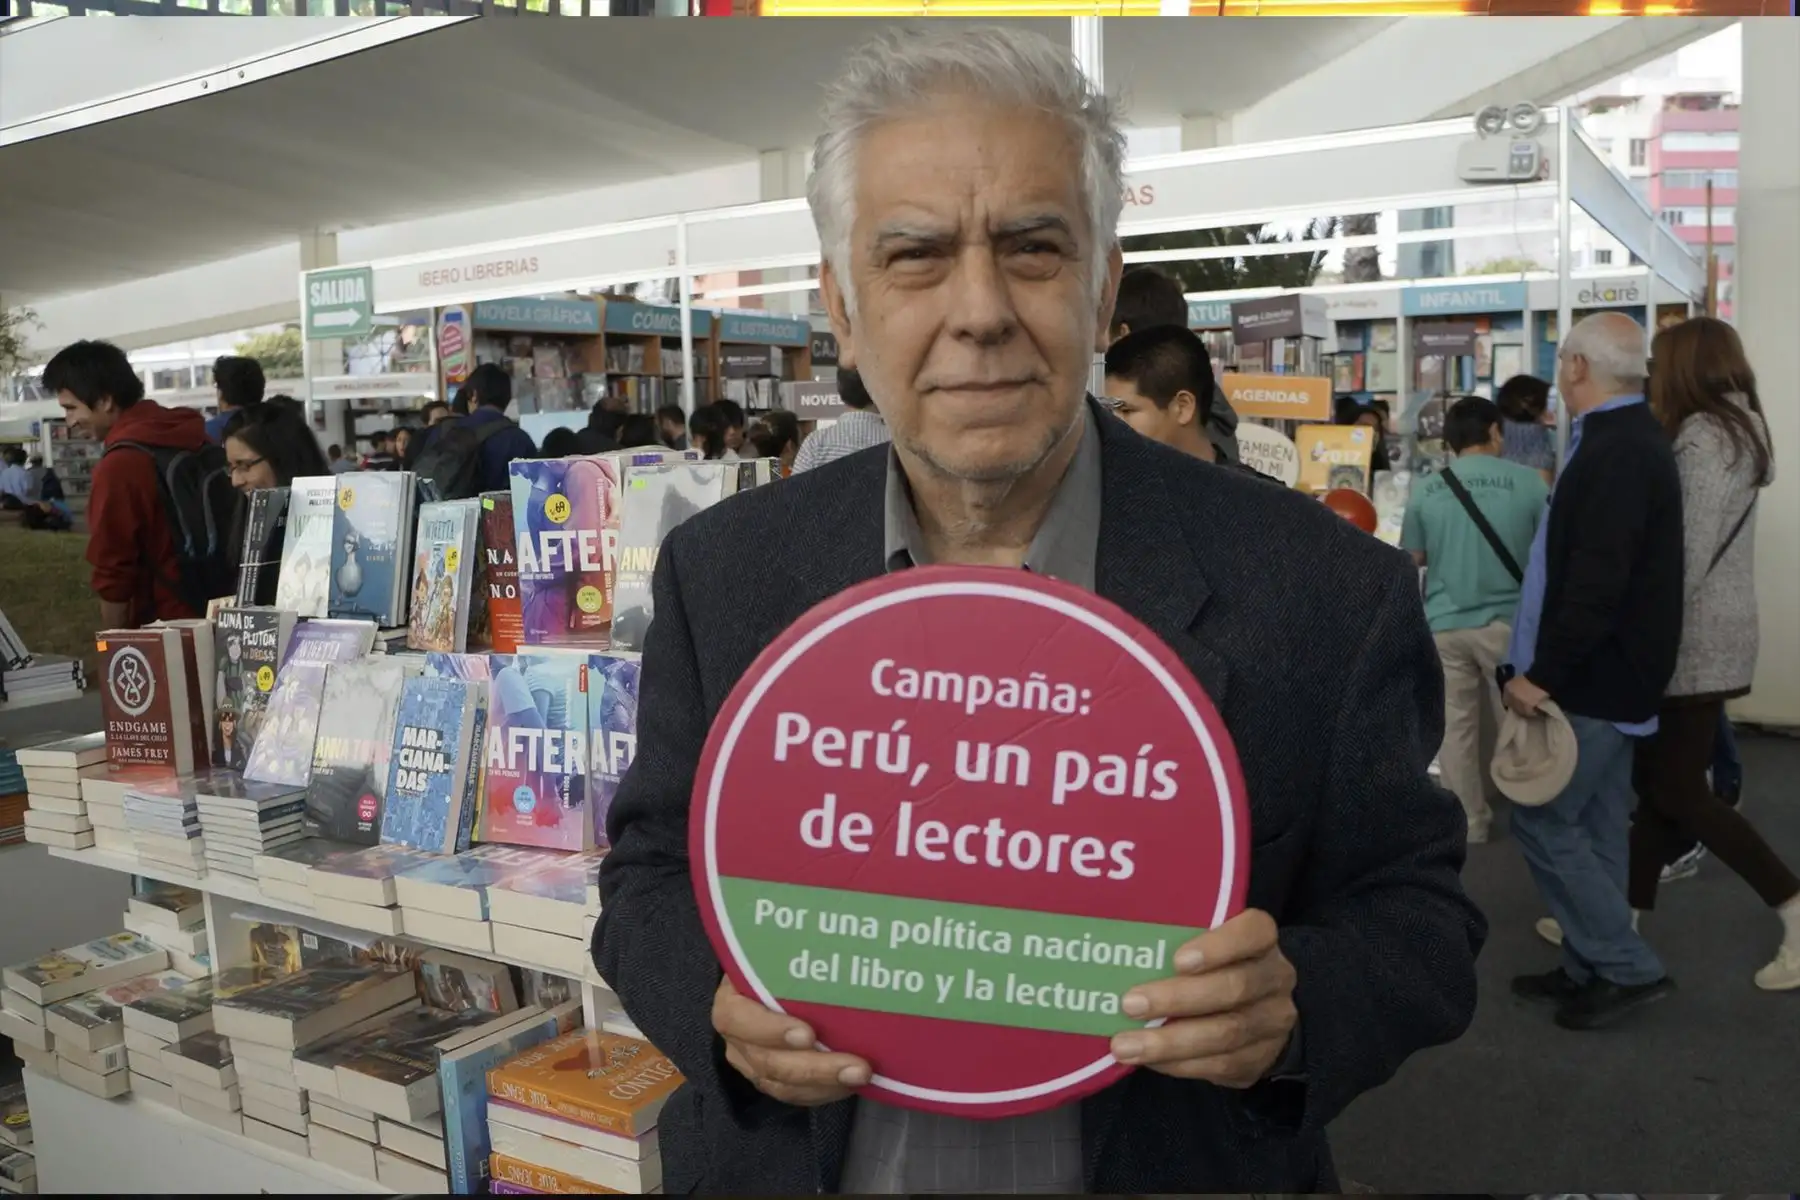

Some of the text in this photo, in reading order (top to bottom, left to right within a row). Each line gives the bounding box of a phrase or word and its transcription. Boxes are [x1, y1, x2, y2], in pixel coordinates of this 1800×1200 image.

[419, 257, 539, 286] IBERO LIBRERIAS
[310, 277, 366, 307] SALIDA
[1419, 290, 1506, 308] INFANTIL
[1577, 281, 1639, 304] ekaré
[476, 305, 531, 322] NOVELA
[632, 308, 682, 331] CÓMIC
[812, 339, 838, 357] CAJ
[801, 395, 845, 407] NOVEL
[1231, 389, 1310, 404] AGENDAS
[518, 529, 620, 573] AFTER
[218, 612, 255, 629] LUNA DE
[871, 659, 1092, 714] Campaña:
[109, 721, 167, 733] ENDGAME
[402, 726, 442, 749] MAR-
[112, 746, 169, 759] JAMES FREY
[399, 748, 450, 773] CIANA-
[488, 726, 585, 774] AFTER
[591, 729, 637, 775] AFT
[774, 712, 1180, 805] Perú, un país
[396, 769, 428, 792] DAS
[800, 794, 1136, 880] de lectores
[754, 899, 1166, 970] Por una política nacional
[789, 950, 1120, 1016] del libro y la lectura
[609, 1059, 680, 1100] CONTIG
[508, 1165, 533, 1185] JEANS
